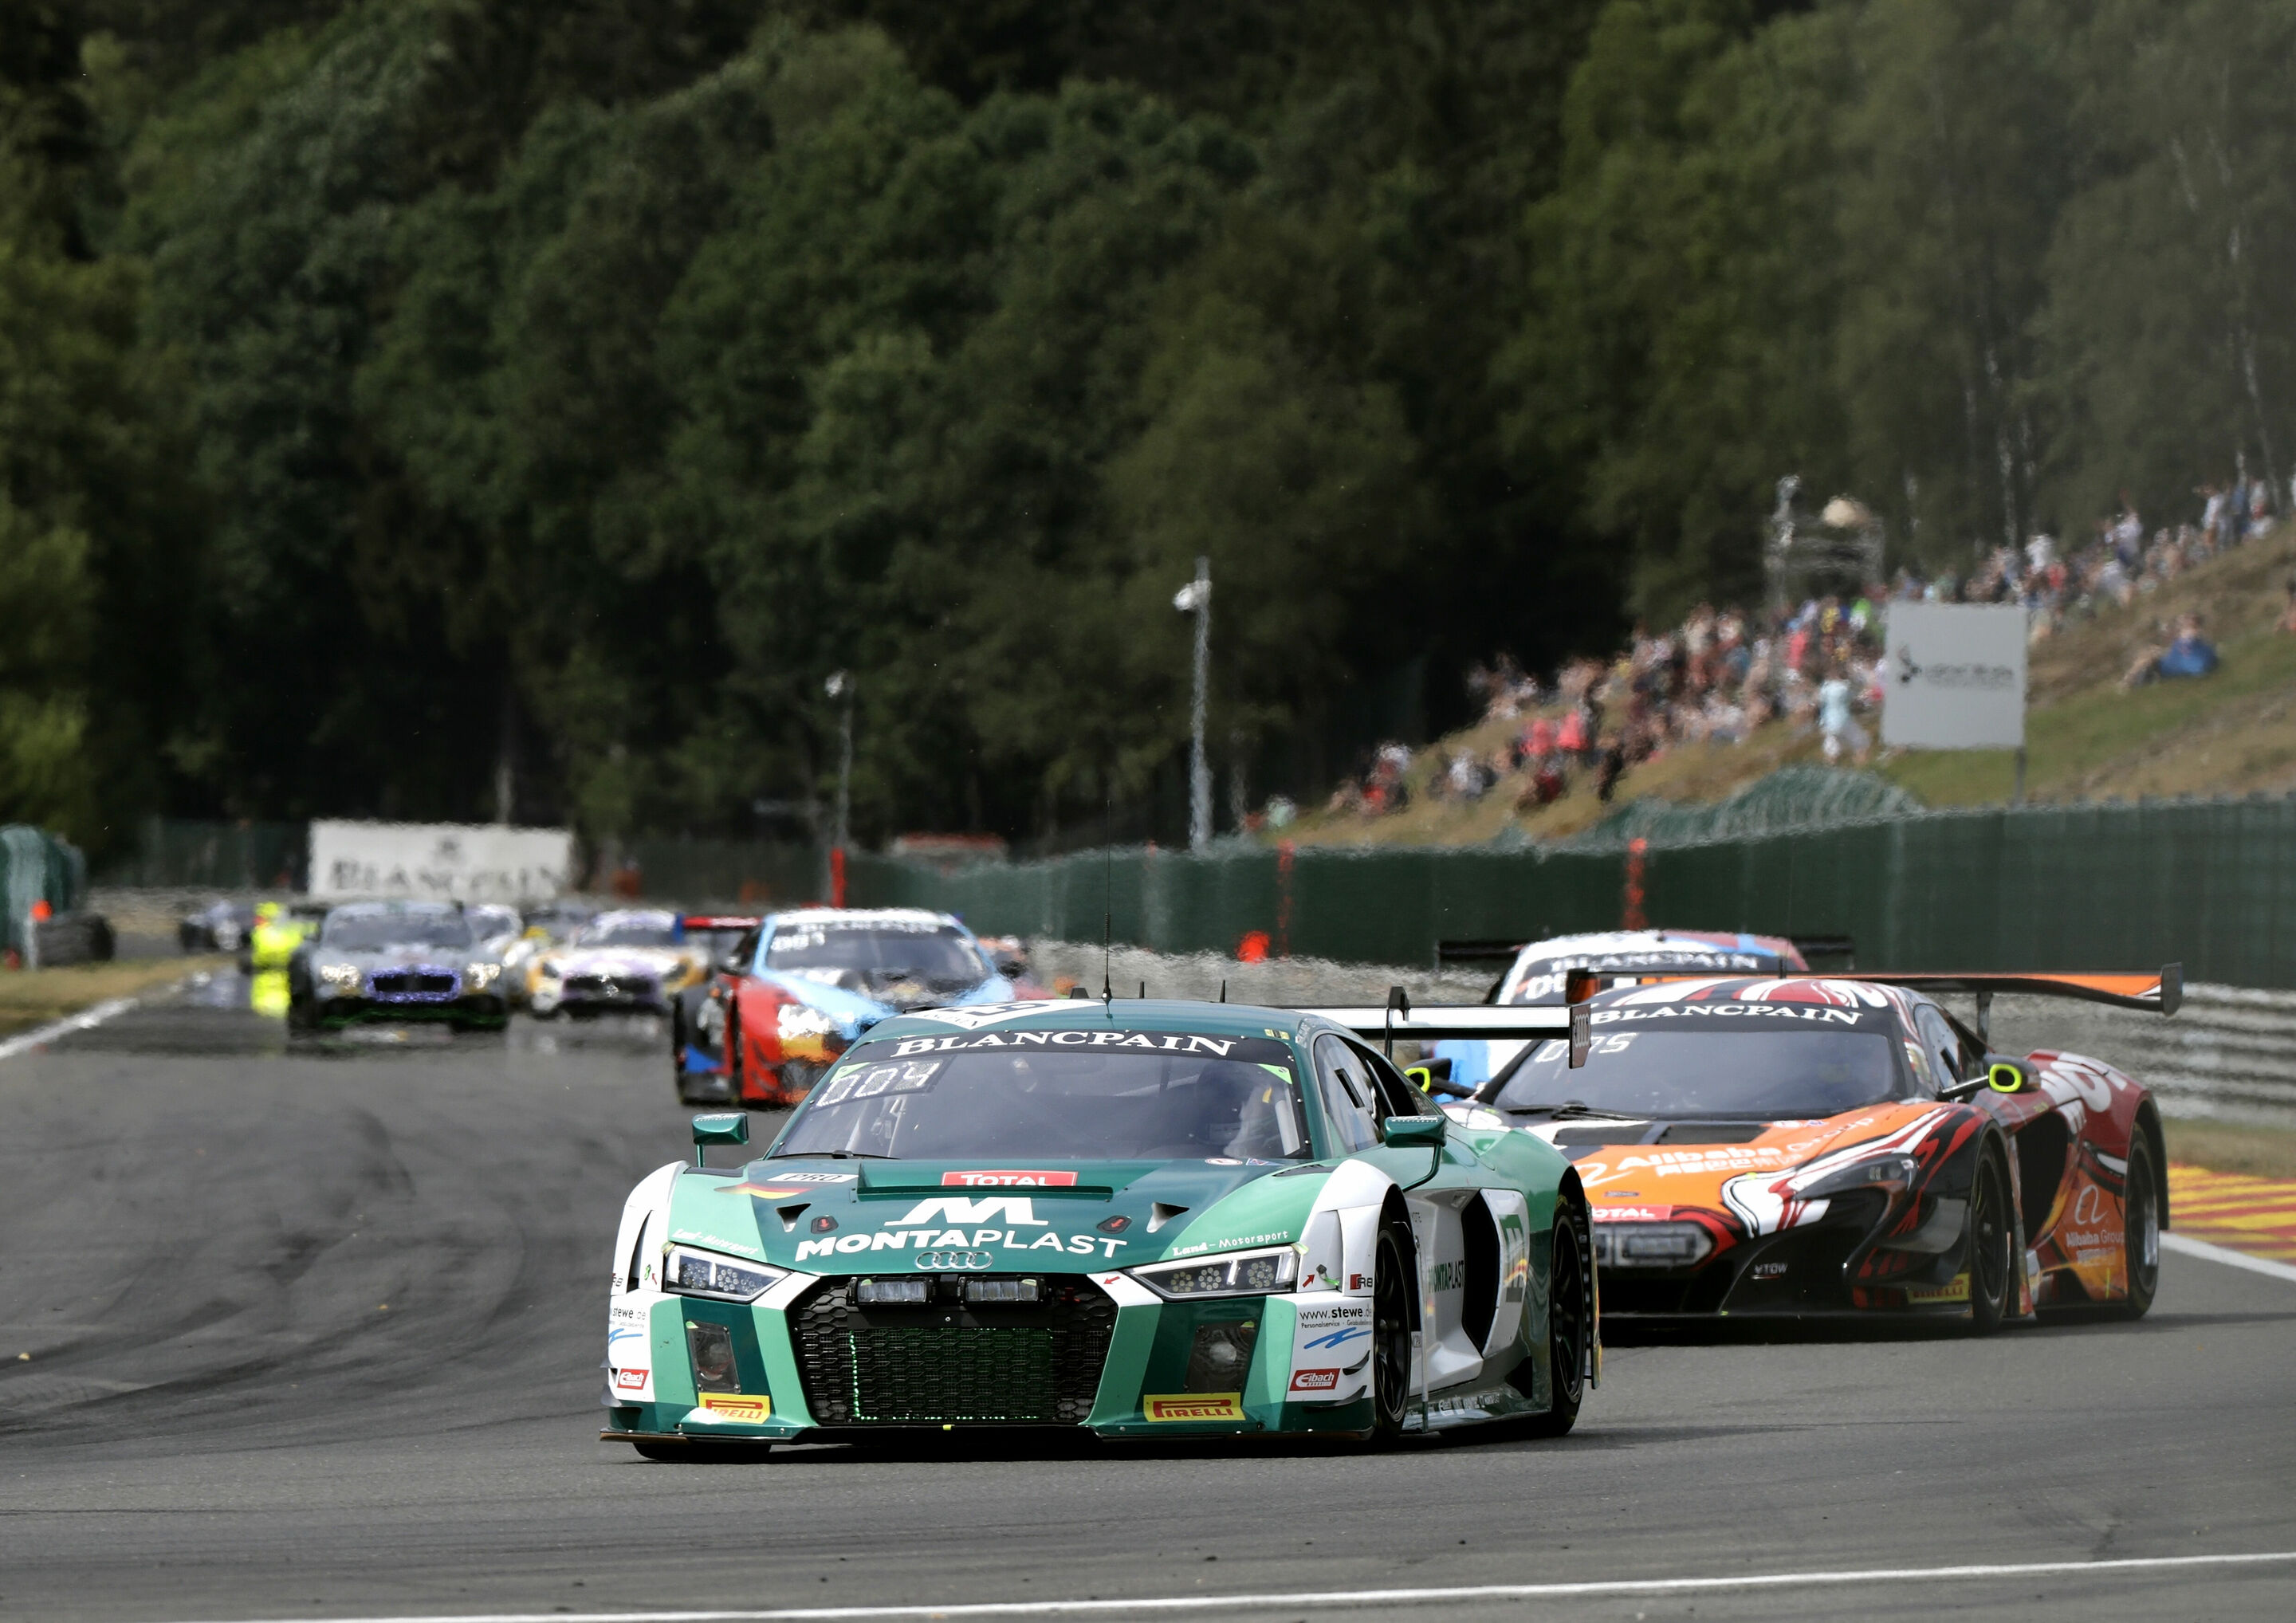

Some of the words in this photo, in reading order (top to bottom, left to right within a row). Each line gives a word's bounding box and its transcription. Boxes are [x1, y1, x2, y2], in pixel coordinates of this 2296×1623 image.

[1590, 1004, 1863, 1025] BLANCPAIN
[890, 1032, 1237, 1057] BLANCPAIN
[816, 1059, 940, 1107] 004
[1616, 1147, 1783, 1170] Alibaba
[960, 1173, 1049, 1186] TOTAL
[1592, 1207, 1656, 1219] OTAL
[795, 1229, 1128, 1262] MONTAPLAST
[1357, 1277, 1373, 1287] R8
[1301, 1319, 1340, 1330] Personalservice
[1295, 1372, 1335, 1387] Eibach
[1153, 1399, 1233, 1417] PIRELLI
